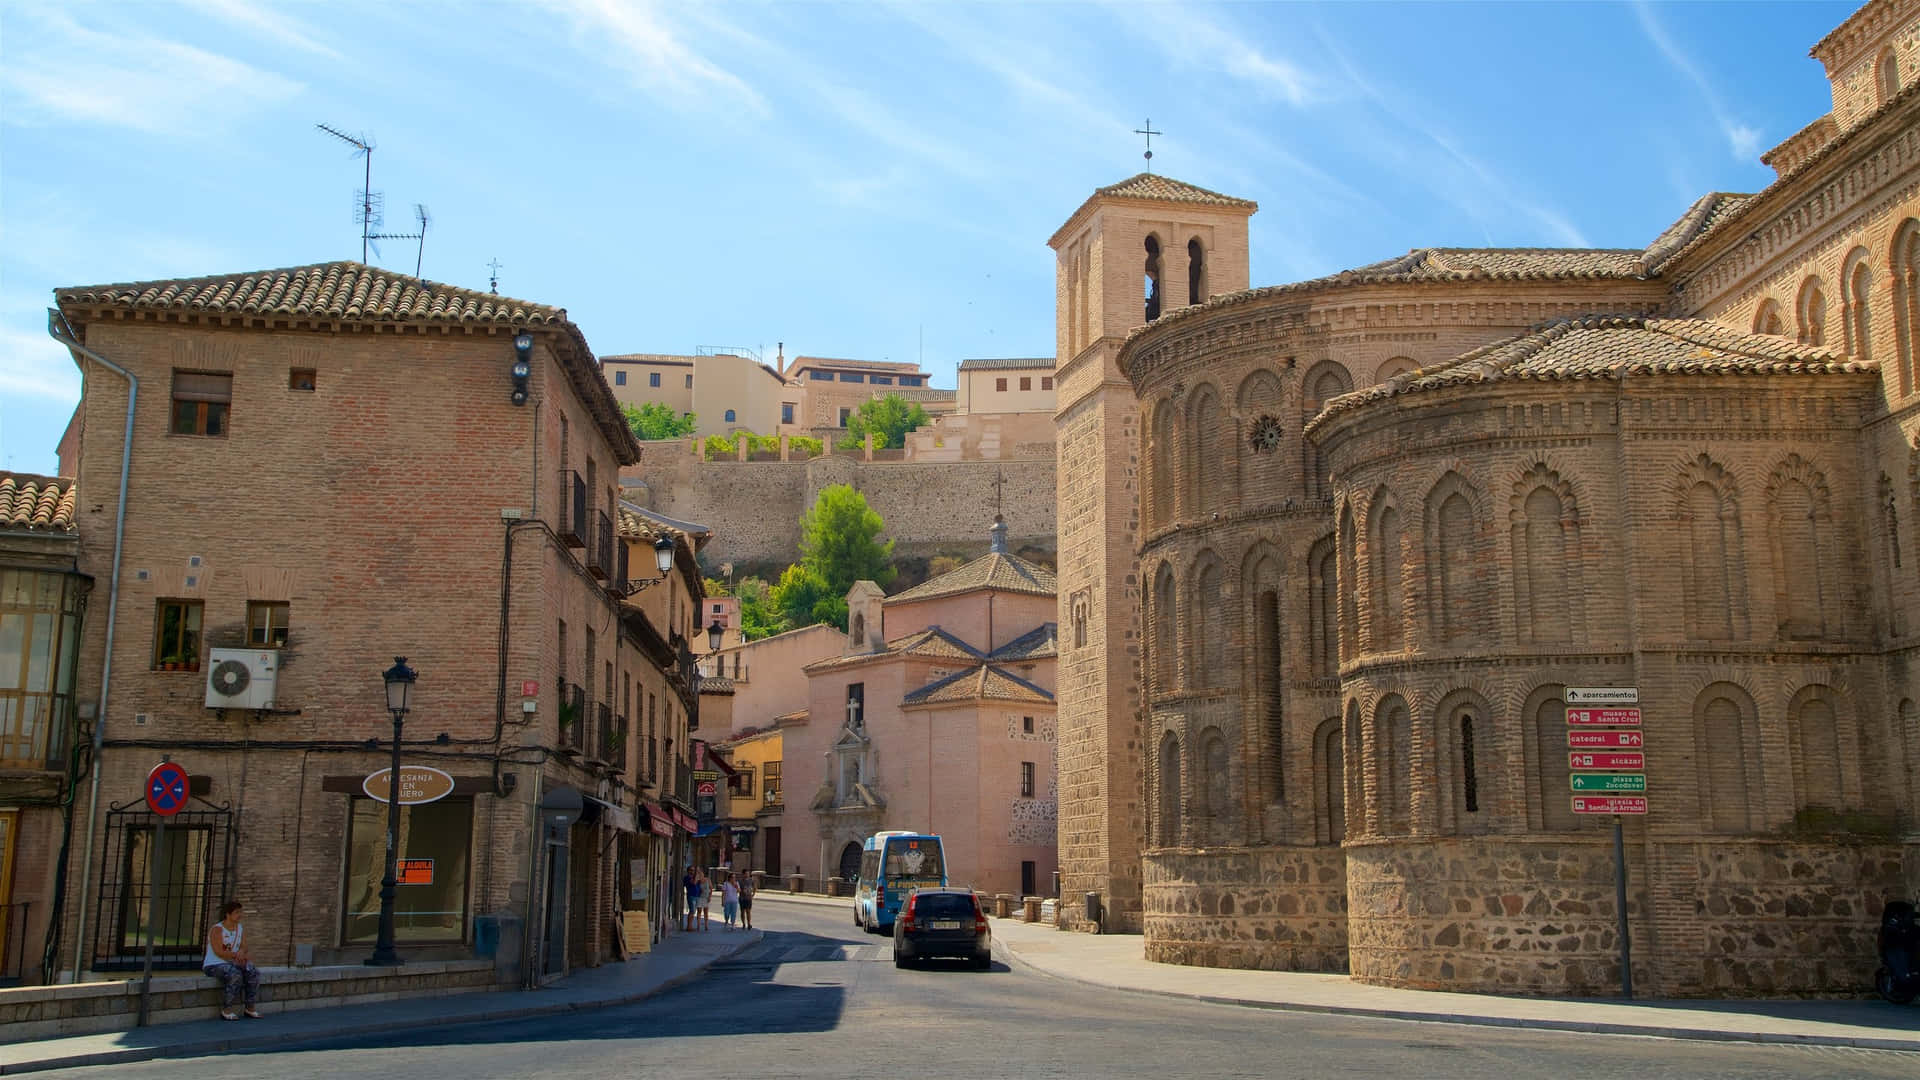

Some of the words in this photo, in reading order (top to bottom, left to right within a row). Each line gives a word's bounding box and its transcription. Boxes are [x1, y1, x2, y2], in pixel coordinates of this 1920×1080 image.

[1582, 691, 1637, 699] aparcamientos
[1570, 735, 1606, 743] catedral
[382, 774, 433, 783] AESANIA
[399, 790, 424, 798] UERO
[407, 860, 432, 869] ALQUILA
